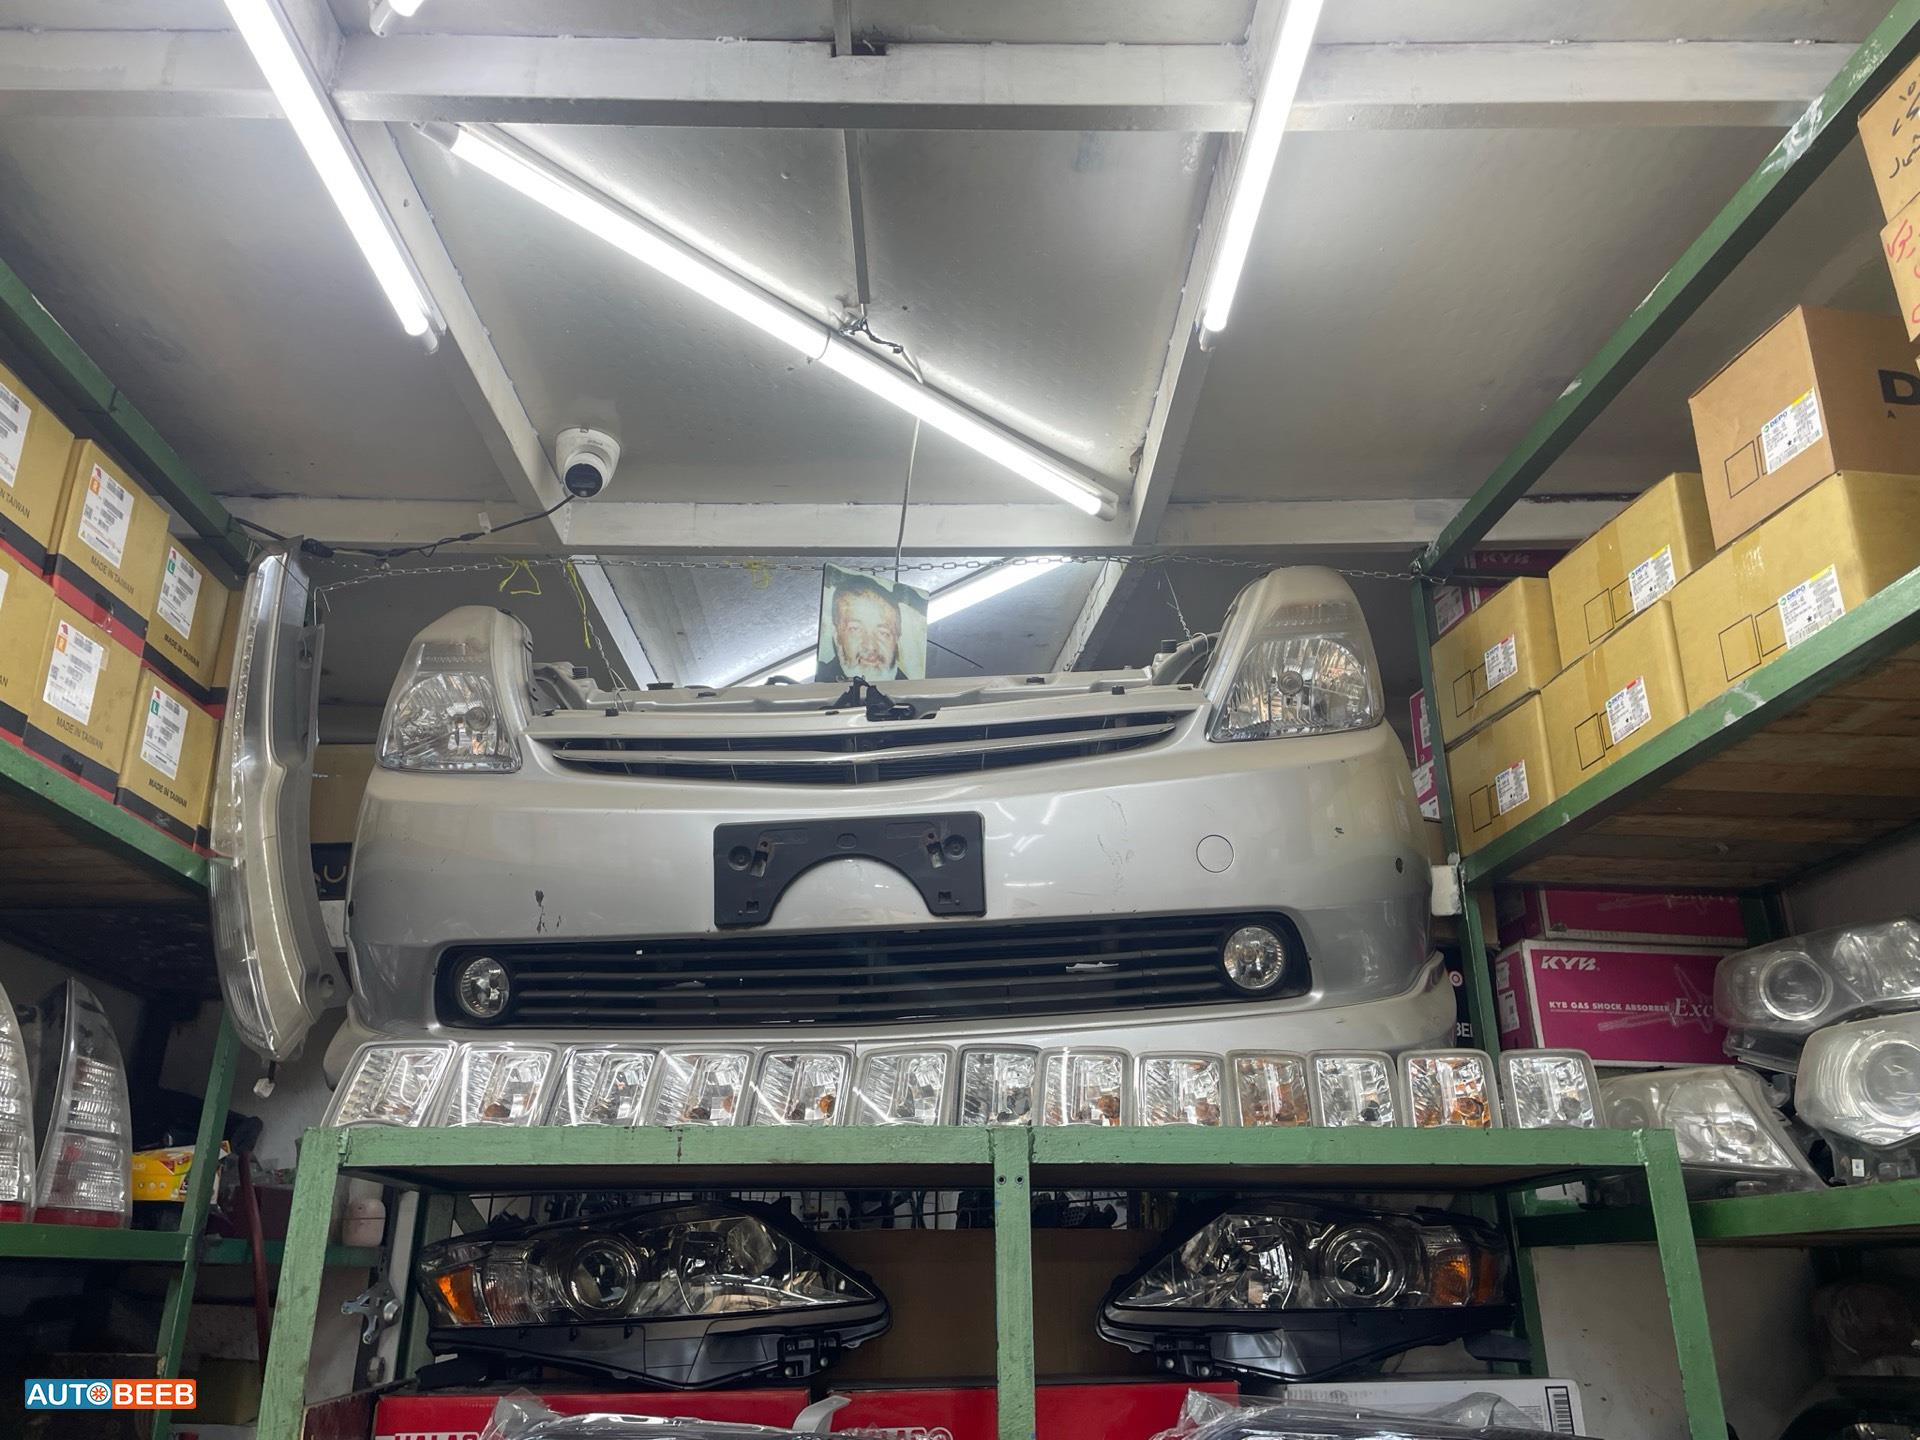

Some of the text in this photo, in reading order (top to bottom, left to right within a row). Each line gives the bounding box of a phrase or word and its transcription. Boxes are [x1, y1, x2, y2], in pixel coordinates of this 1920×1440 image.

[1770, 411, 1788, 428] DEPO
[6, 493, 31, 519] TAIWAN
[91, 555, 108, 576] MADE
[1787, 585, 1806, 601] DEPO
[56, 716, 75, 734] MADE
[80, 731, 104, 751] TAIWAN
[148, 778, 165, 794] MADE
[169, 791, 188, 809] TAIWAN
[1541, 956, 1596, 971] KYB
[1549, 1001, 1568, 1010] KYB
[1571, 1002, 1590, 1010] GAS
[1592, 1002, 1623, 1011] SHOCK
[1625, 1003, 1670, 1013] ABSORBER
